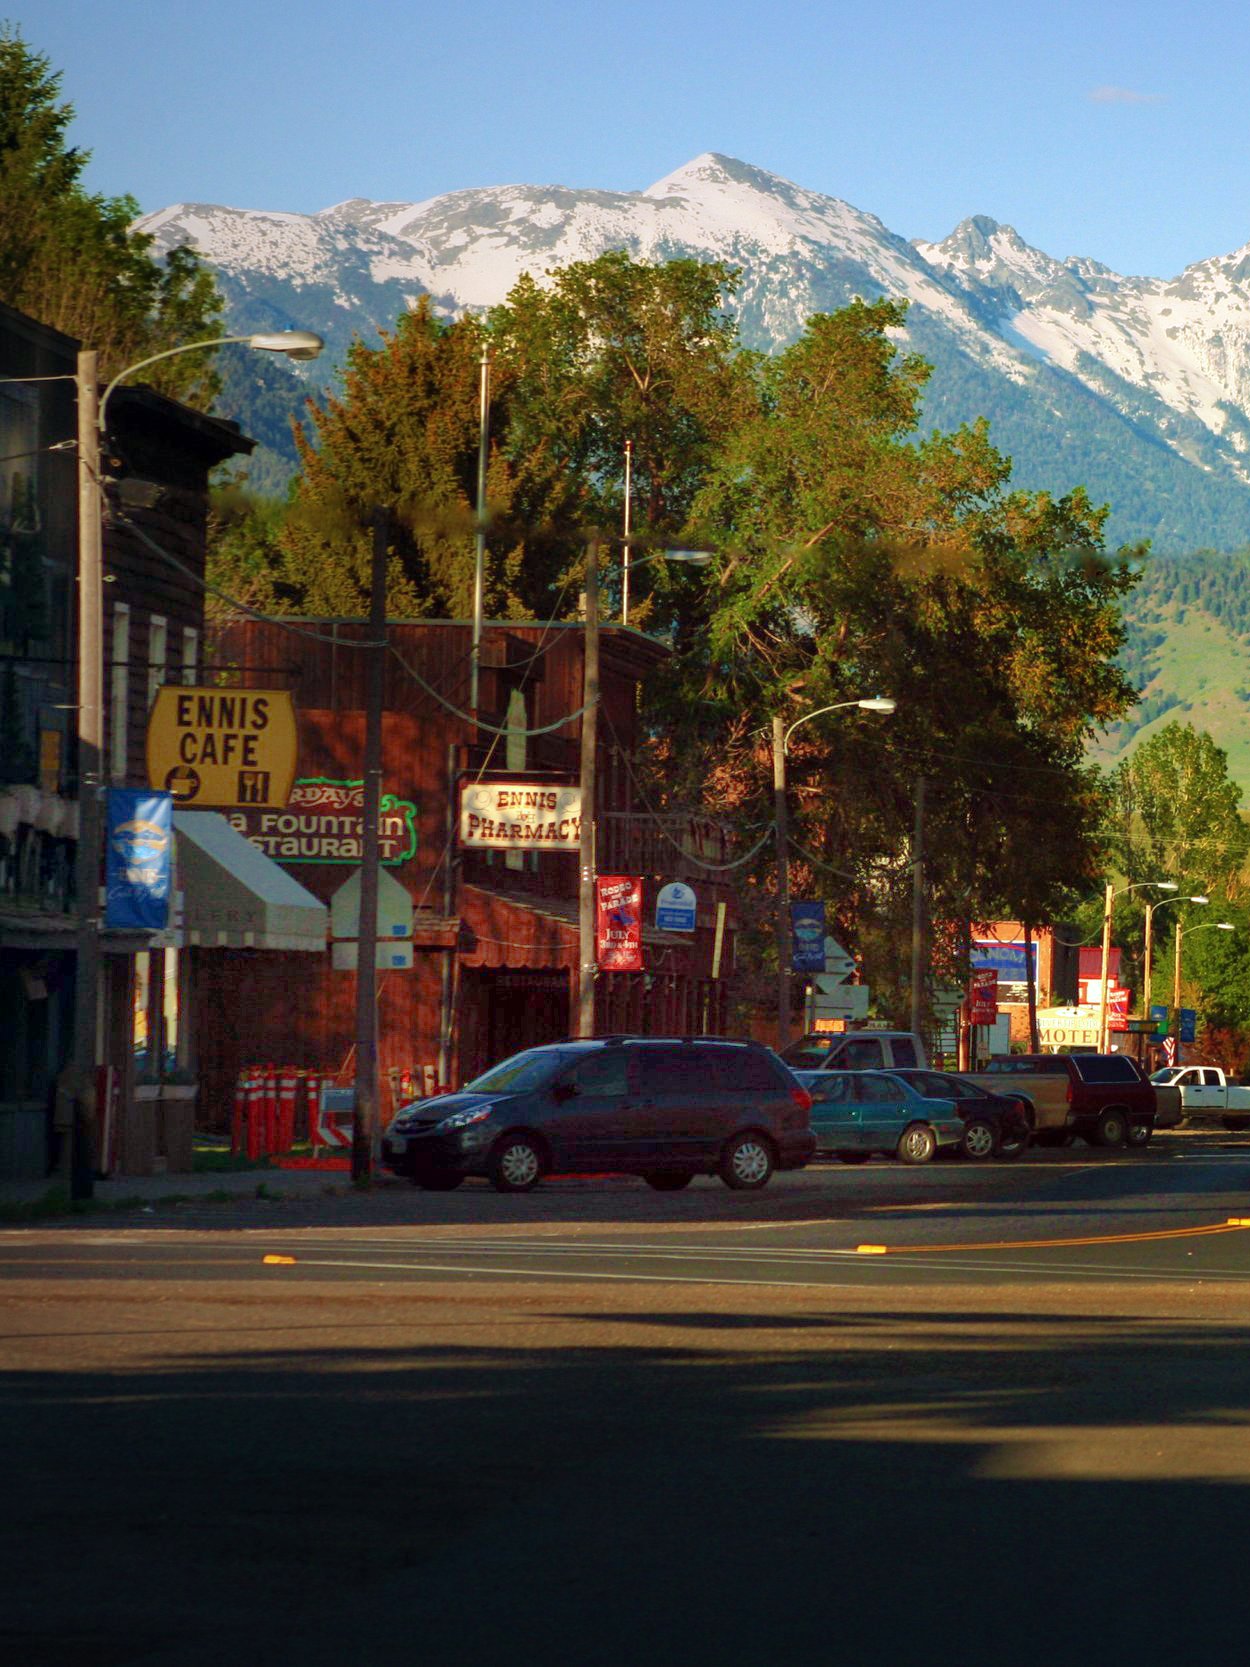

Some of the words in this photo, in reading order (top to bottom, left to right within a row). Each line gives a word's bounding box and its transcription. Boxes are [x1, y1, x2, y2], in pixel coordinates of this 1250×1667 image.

[177, 694, 269, 730] ENNIS
[180, 732, 259, 767] CAFE
[497, 791, 557, 810] ENNIS
[468, 813, 581, 841] PHARMACY
[601, 881, 632, 897] RODEO
[601, 893, 639, 912] PARADE
[606, 929, 630, 941] JULY
